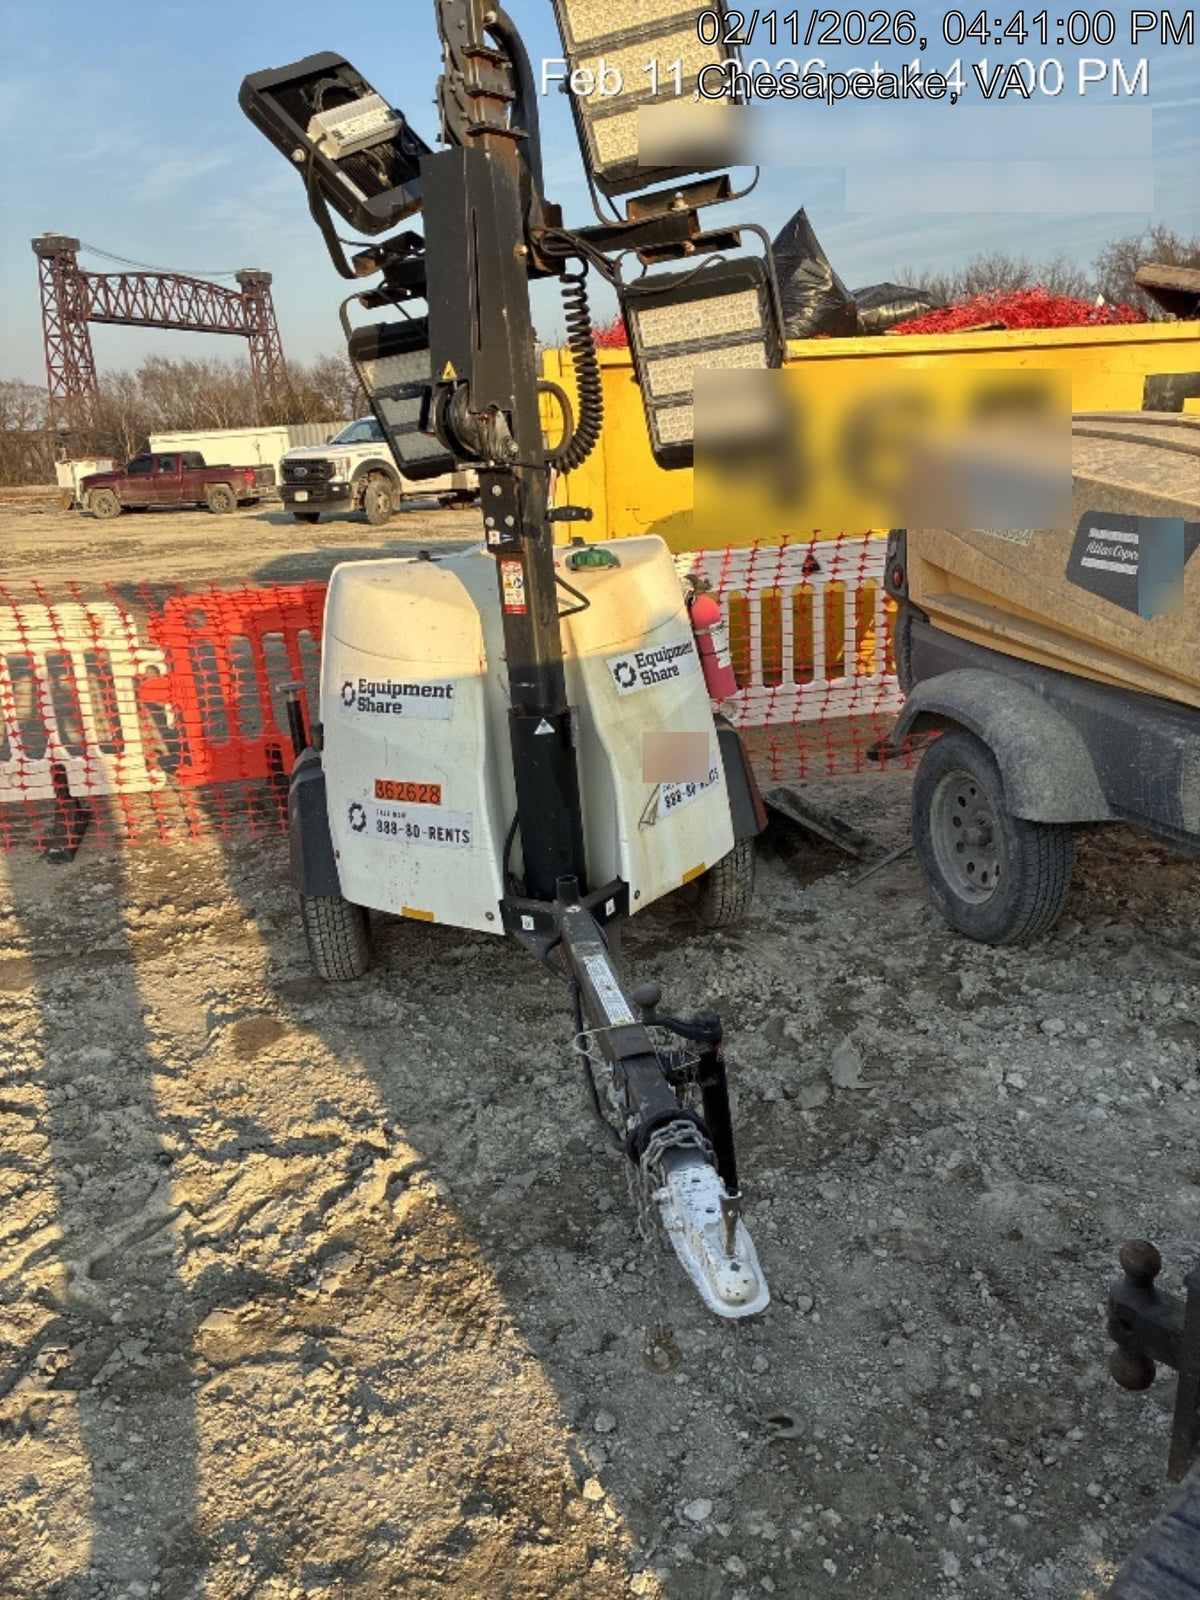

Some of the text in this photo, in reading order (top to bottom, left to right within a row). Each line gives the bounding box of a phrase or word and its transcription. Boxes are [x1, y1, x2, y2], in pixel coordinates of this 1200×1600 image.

[640, 665, 680, 685] Share
[358, 679, 454, 699] Equipment
[357, 697, 403, 714] Share
[375, 780, 441, 804] 362628
